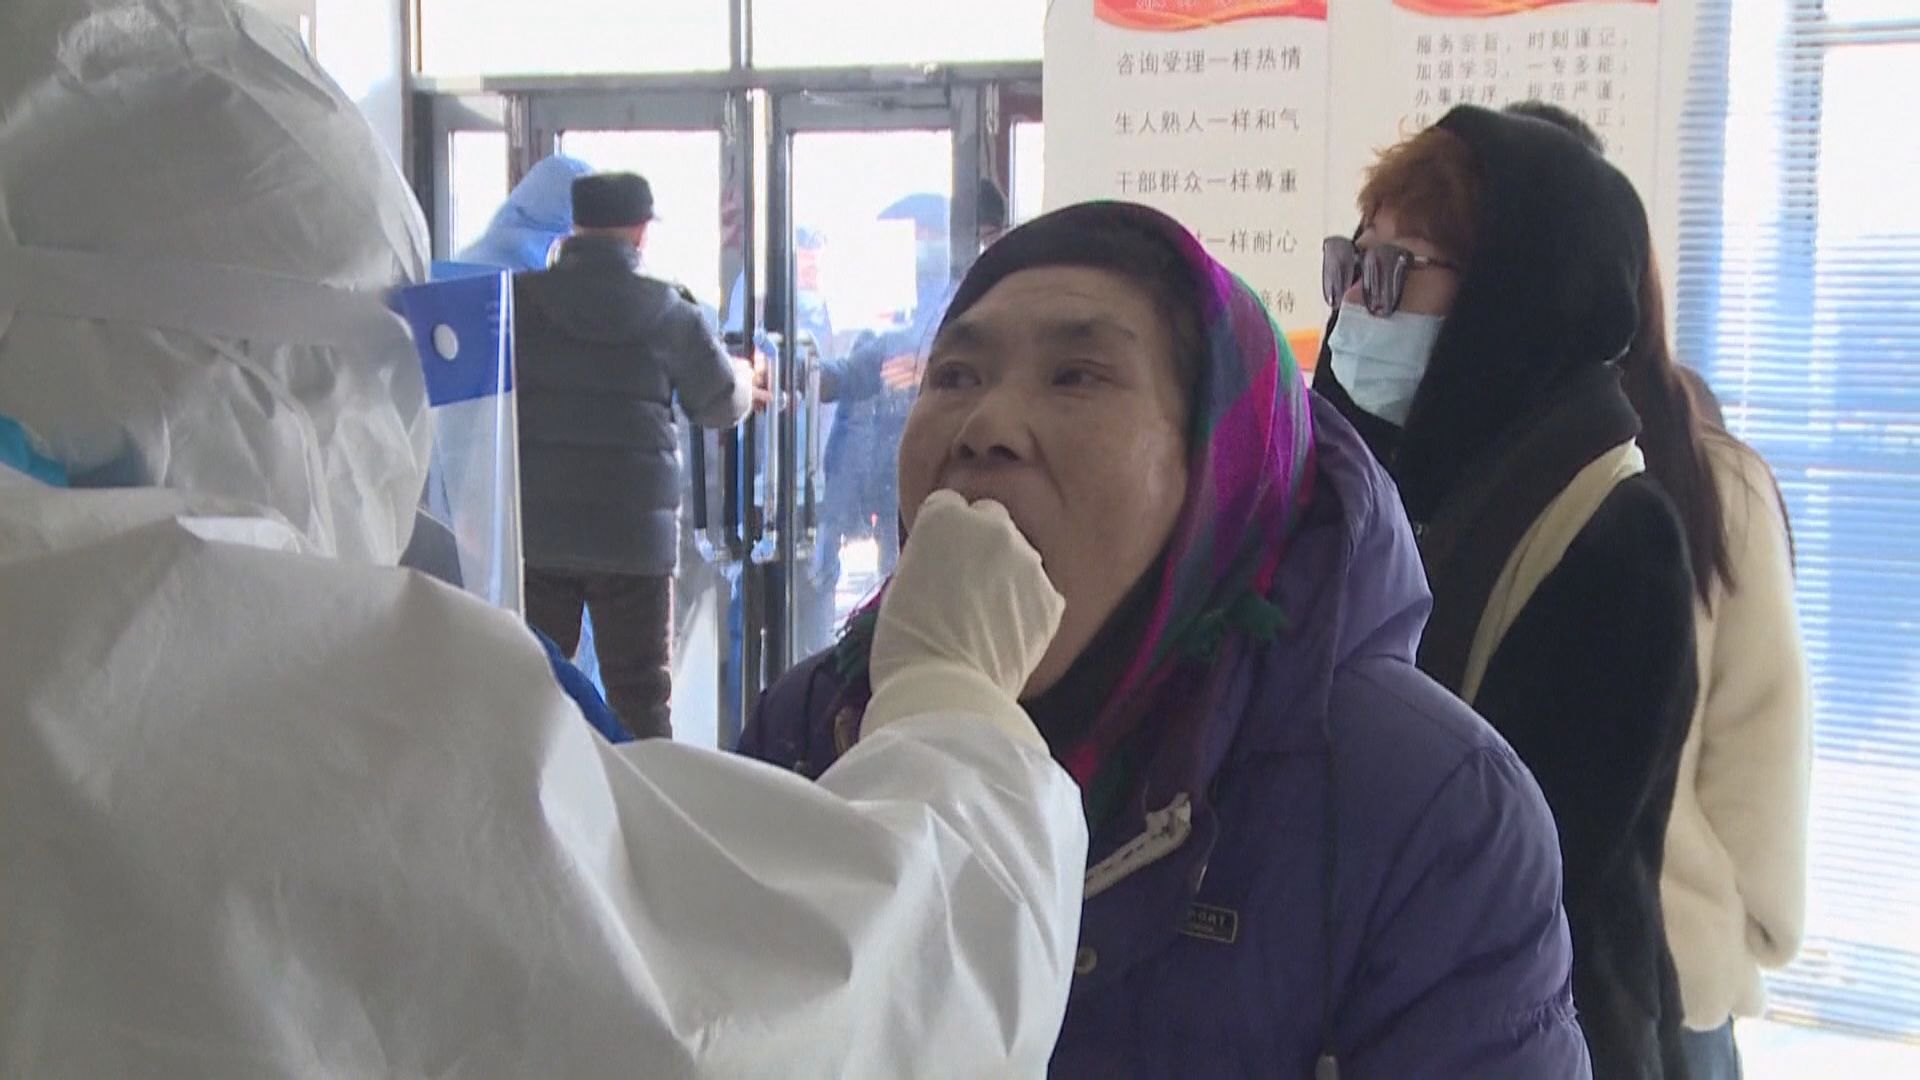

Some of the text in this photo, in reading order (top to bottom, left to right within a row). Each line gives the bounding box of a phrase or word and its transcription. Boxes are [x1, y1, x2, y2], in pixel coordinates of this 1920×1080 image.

[1117, 46, 1301, 76] 咨询受理一样热情
[1115, 107, 1300, 136] 生人熟人一样和气
[1115, 168, 1297, 193] 干部群众一样尊重
[1197, 228, 1298, 254] 一样耐心
